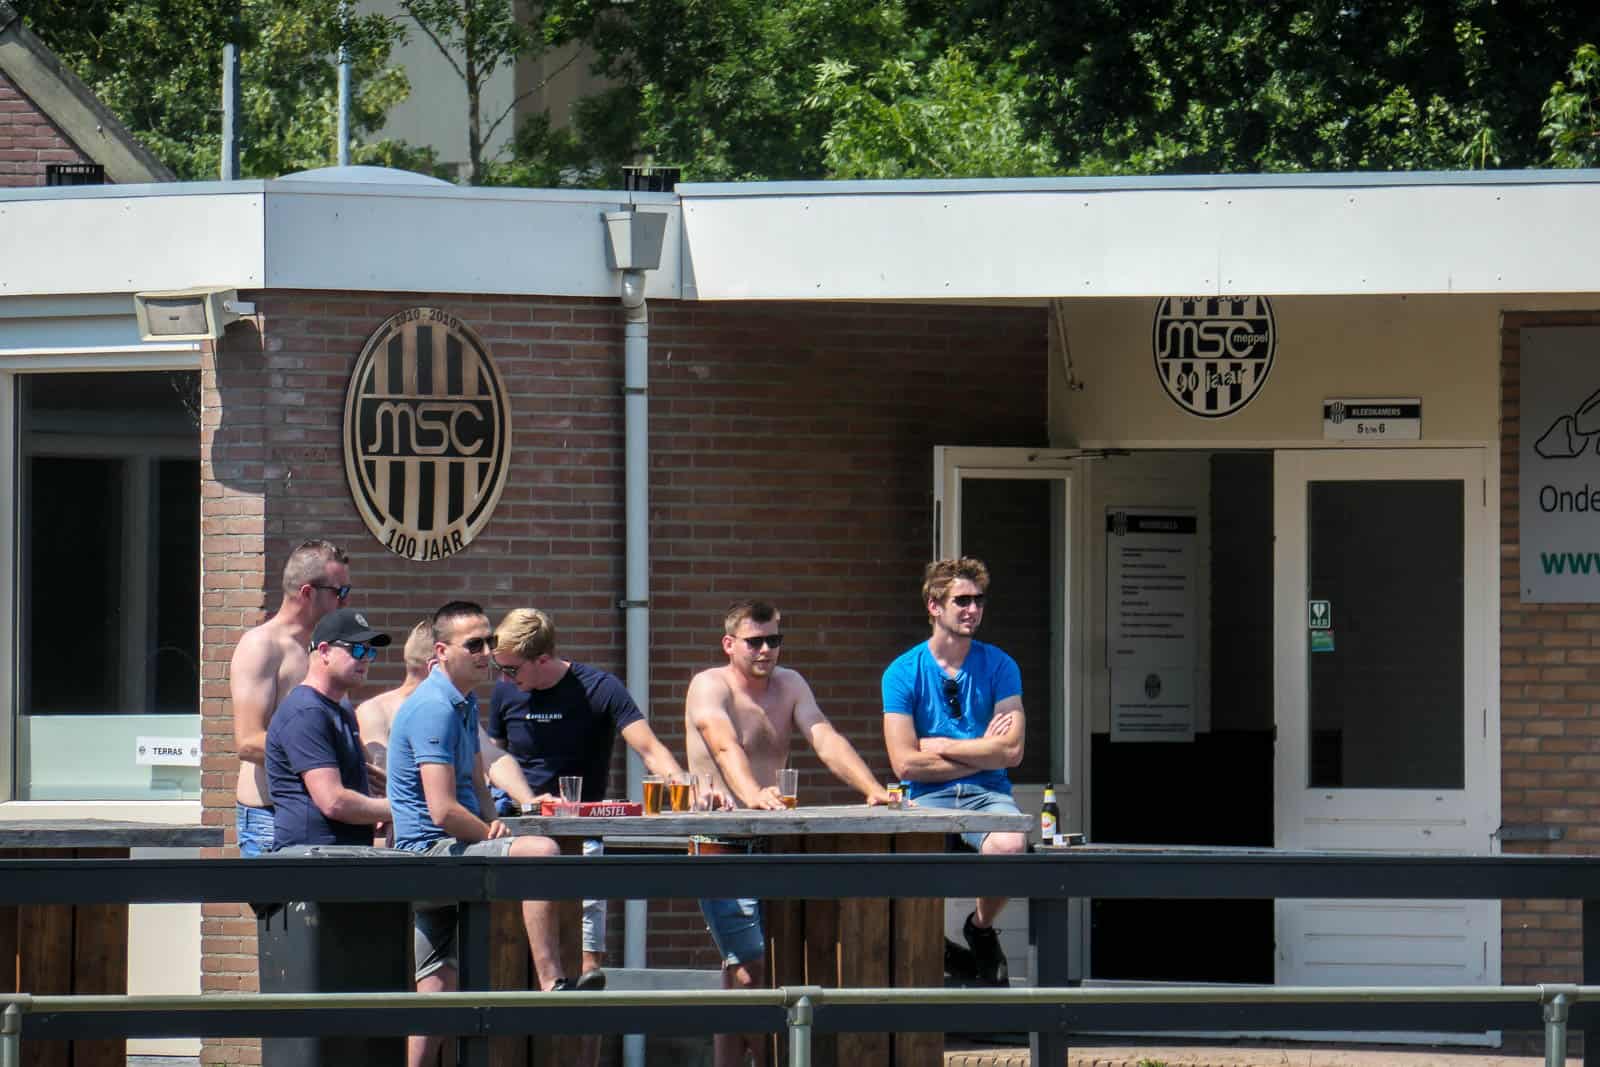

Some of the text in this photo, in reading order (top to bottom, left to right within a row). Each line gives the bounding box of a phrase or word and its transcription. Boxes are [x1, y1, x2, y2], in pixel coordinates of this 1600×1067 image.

[1233, 331, 1268, 348] meppel
[1176, 368, 1248, 393] 90 jaar
[1357, 423, 1364, 434] 5
[1379, 423, 1385, 434] 6
[385, 528, 464, 560] 100 JAAR
[152, 747, 183, 755] TERRAS
[589, 806, 627, 816] AMSTEL
